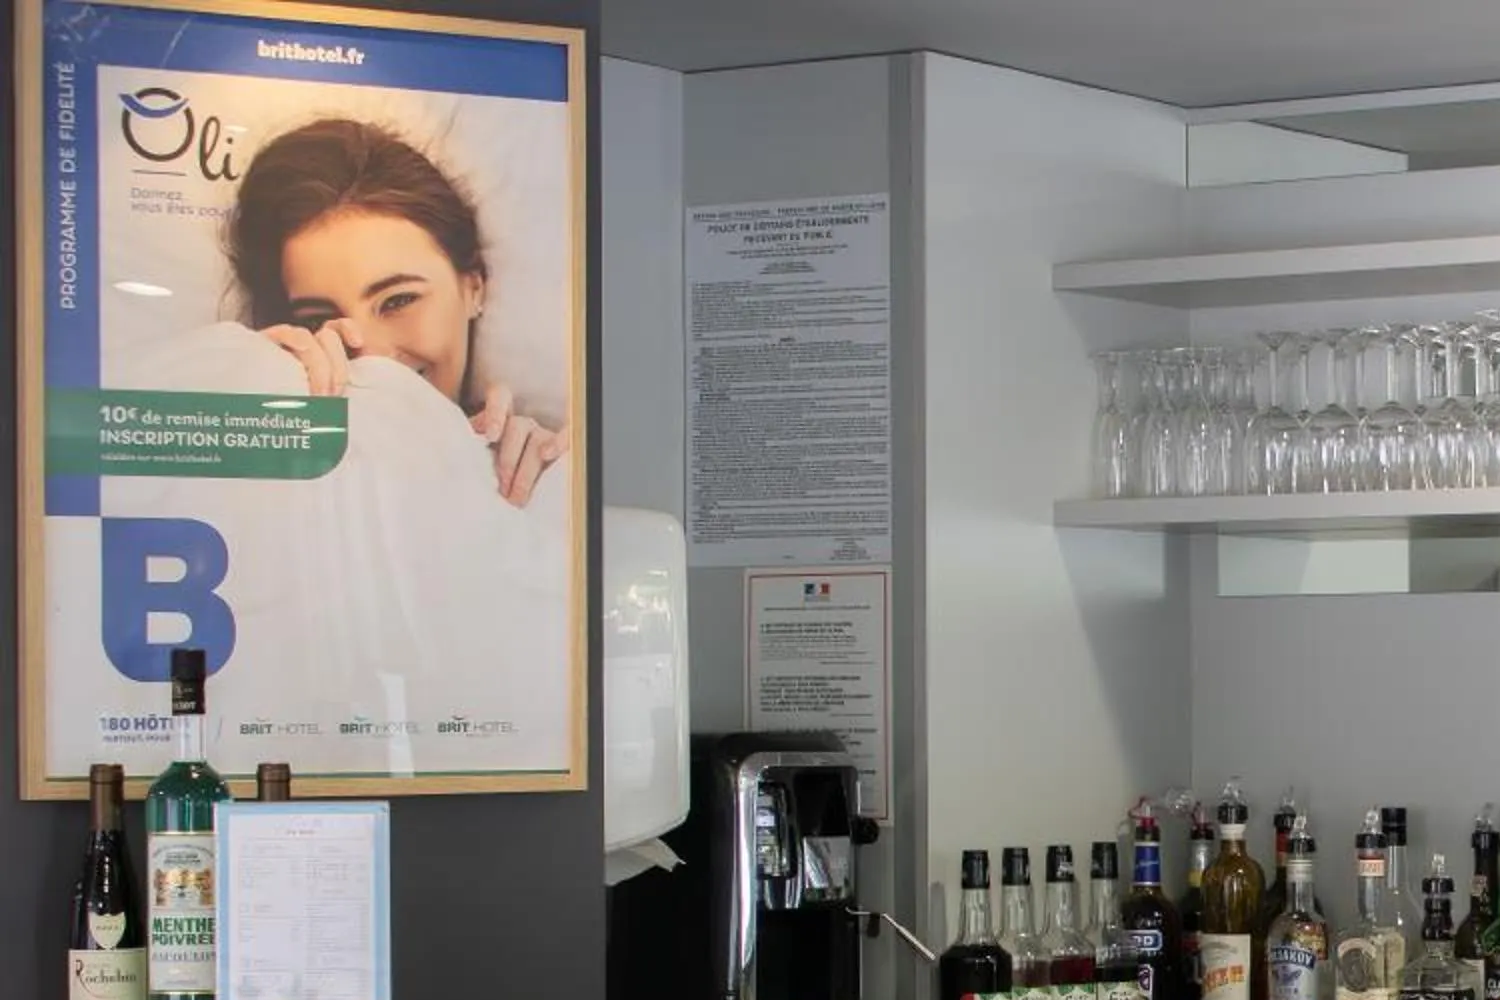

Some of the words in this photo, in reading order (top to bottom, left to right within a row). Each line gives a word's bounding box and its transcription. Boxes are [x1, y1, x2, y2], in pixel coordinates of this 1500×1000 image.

[257, 40, 365, 64] brithotel.fr
[118, 87, 241, 181] Oli
[59, 142, 76, 174] DE
[59, 180, 77, 309] PROGRAMME
[101, 406, 139, 423] 10€
[141, 411, 162, 426] de
[167, 412, 220, 428] remise
[225, 412, 310, 430] immédiate
[101, 430, 219, 447] INSCRIPTION
[223, 434, 310, 449] GRATUITE
[101, 517, 237, 683] B
[100, 717, 131, 731] 180
[134, 713, 177, 732] HÔT
[153, 917, 216, 932] MENTHE
